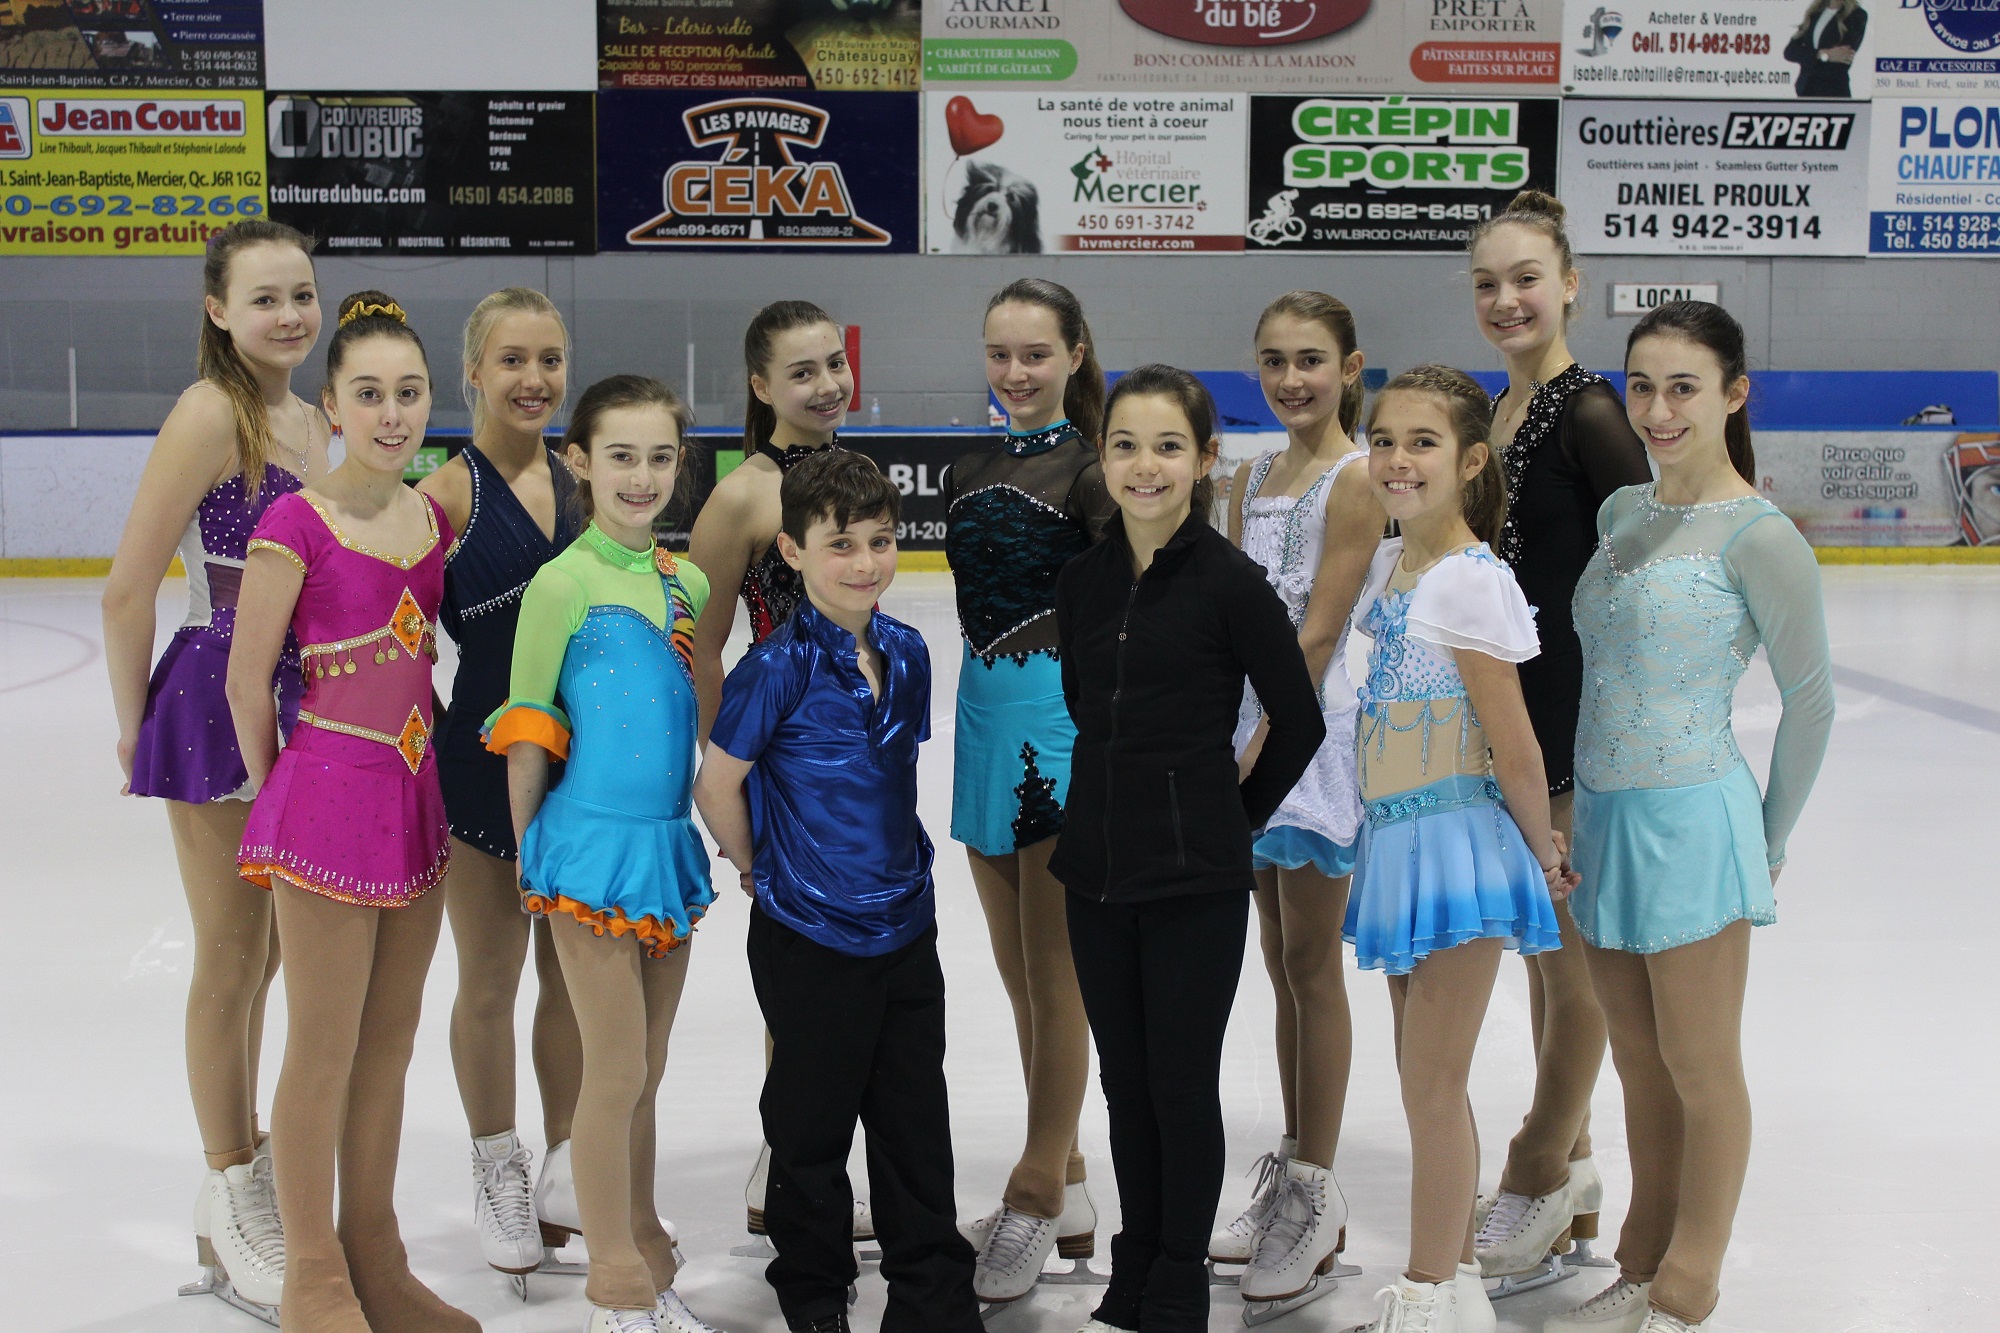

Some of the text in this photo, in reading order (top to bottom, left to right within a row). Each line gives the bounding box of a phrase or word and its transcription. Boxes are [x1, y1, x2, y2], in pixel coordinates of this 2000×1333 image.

[170, 13, 221, 21] Terre noire
[946, 16, 1061, 29] GOURMAND
[1205, 3, 1282, 27] du blé
[1648, 12, 1757, 26] Acheter & Vendre
[620, 16, 648, 35] Bar
[717, 16, 753, 36] vidéo
[1430, 19, 1537, 32] EMPORTER
[180, 31, 207, 40] Pierre
[1632, 32, 1664, 53] Cell.
[604, 45, 638, 57] SALLE
[641, 46, 656, 57] DE
[816, 50, 917, 65] Châteauguay
[936, 48, 1060, 59] CHARCUTERIE MAISON
[1422, 48, 1556, 63] PÂTISSERIES FRAÎCHES
[598, 59, 743, 72] Capacité de 150 personnes
[1134, 52, 1356, 68] BON! COMME À LA MAISON
[1880, 60, 1997, 72] GAZ ET ACCESSOIRES
[938, 62, 1053, 75] VARIÉTÉ DE GÂTEAUX
[1448, 64, 1555, 77] FAITES SUR PLACE
[1573, 66, 1791, 86] isabelle.robitaille@remax-quebec.com
[147, 76, 193, 87] Mercier,
[196, 76, 212, 87] Qc
[622, 72, 689, 86] RÉSERVEZ
[691, 72, 716, 86] DÈS
[816, 68, 917, 86] 450-692-1412
[1956, 80, 1978, 88] suite
[488, 100, 566, 112] Asphalte gravier
[1038, 98, 1234, 112] La santé de votre animal
[321, 107, 423, 127] COUVREURS
[700, 112, 811, 135] LES PAVAGES
[1064, 116, 1209, 128] nous tient à coeur
[1298, 96, 1511, 137] CRÉPIN
[1064, 132, 1093, 142] Caring
[1095, 132, 1107, 141] for
[1110, 134, 1129, 143] your
[1132, 134, 1146, 142] pet
[1174, 132, 1207, 143] passion
[1579, 116, 1850, 147] Gouttières EXPERT
[96, 142, 127, 156] Jacques
[322, 126, 424, 158] DUBUC
[1116, 150, 1172, 168] Hôpital
[1292, 149, 1524, 184] SPORTS
[1587, 159, 1839, 174] Gouttières sans joint Seamless Gutter System
[9, 170, 134, 190] Saint-Jean-Baptiste,
[137, 171, 187, 189] Mercier,
[212, 171, 233, 187] J6R
[236, 171, 262, 187] 1G2
[1116, 166, 1201, 181] vétérinaire
[669, 148, 850, 217] CÉKA
[1073, 174, 1201, 203] Mercier
[270, 184, 426, 204] toituredubuc.com
[450, 186, 574, 205] (450) 454.2086
[1618, 183, 1811, 207] DANIEL PROULX
[1896, 193, 1972, 206] Résidentiel
[0, 194, 263, 216] 0-692-8266
[1310, 204, 1492, 220] 450 692-6451
[1078, 215, 1195, 230] 450 691-3742
[1604, 214, 1821, 240] 514 942-3914
[1884, 215, 1954, 232] Tél. 514
[328, 236, 383, 247] COMMERCIAL
[398, 236, 445, 247] INDUSTRIEL
[460, 234, 511, 247] RÉSIDENTIEL
[1312, 229, 1323, 240] 3
[1325, 229, 1391, 241] WILBROD
[1884, 232, 1952, 249] Tel. 450
[1079, 237, 1195, 250] hvmercier.com
[1824, 446, 1904, 465] Parce que
[889, 464, 951, 496] BL
[1822, 465, 1893, 481] voir clair
[1822, 482, 1918, 501] C'est super!
